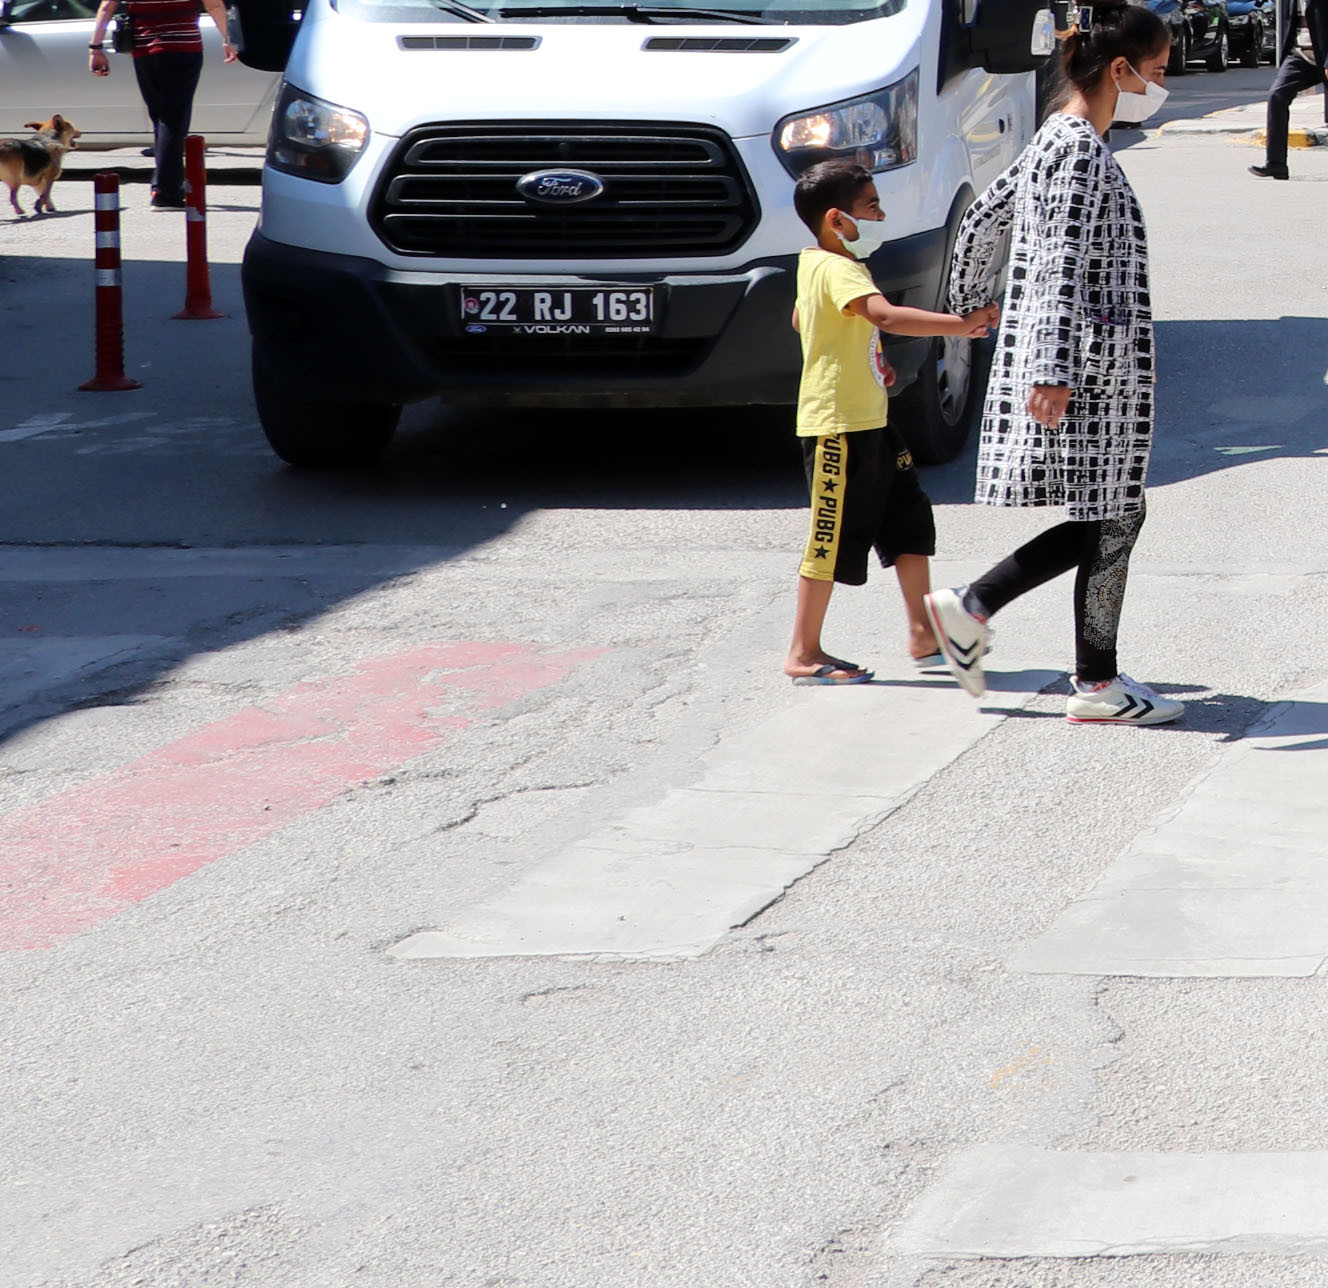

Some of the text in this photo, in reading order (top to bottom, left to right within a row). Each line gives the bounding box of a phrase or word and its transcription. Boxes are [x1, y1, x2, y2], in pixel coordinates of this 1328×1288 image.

[537, 177, 582, 196] Ford
[480, 292, 647, 321] 22 RJ 163
[523, 325, 590, 334] VOLKAN
[814, 495, 838, 543] PUBG
